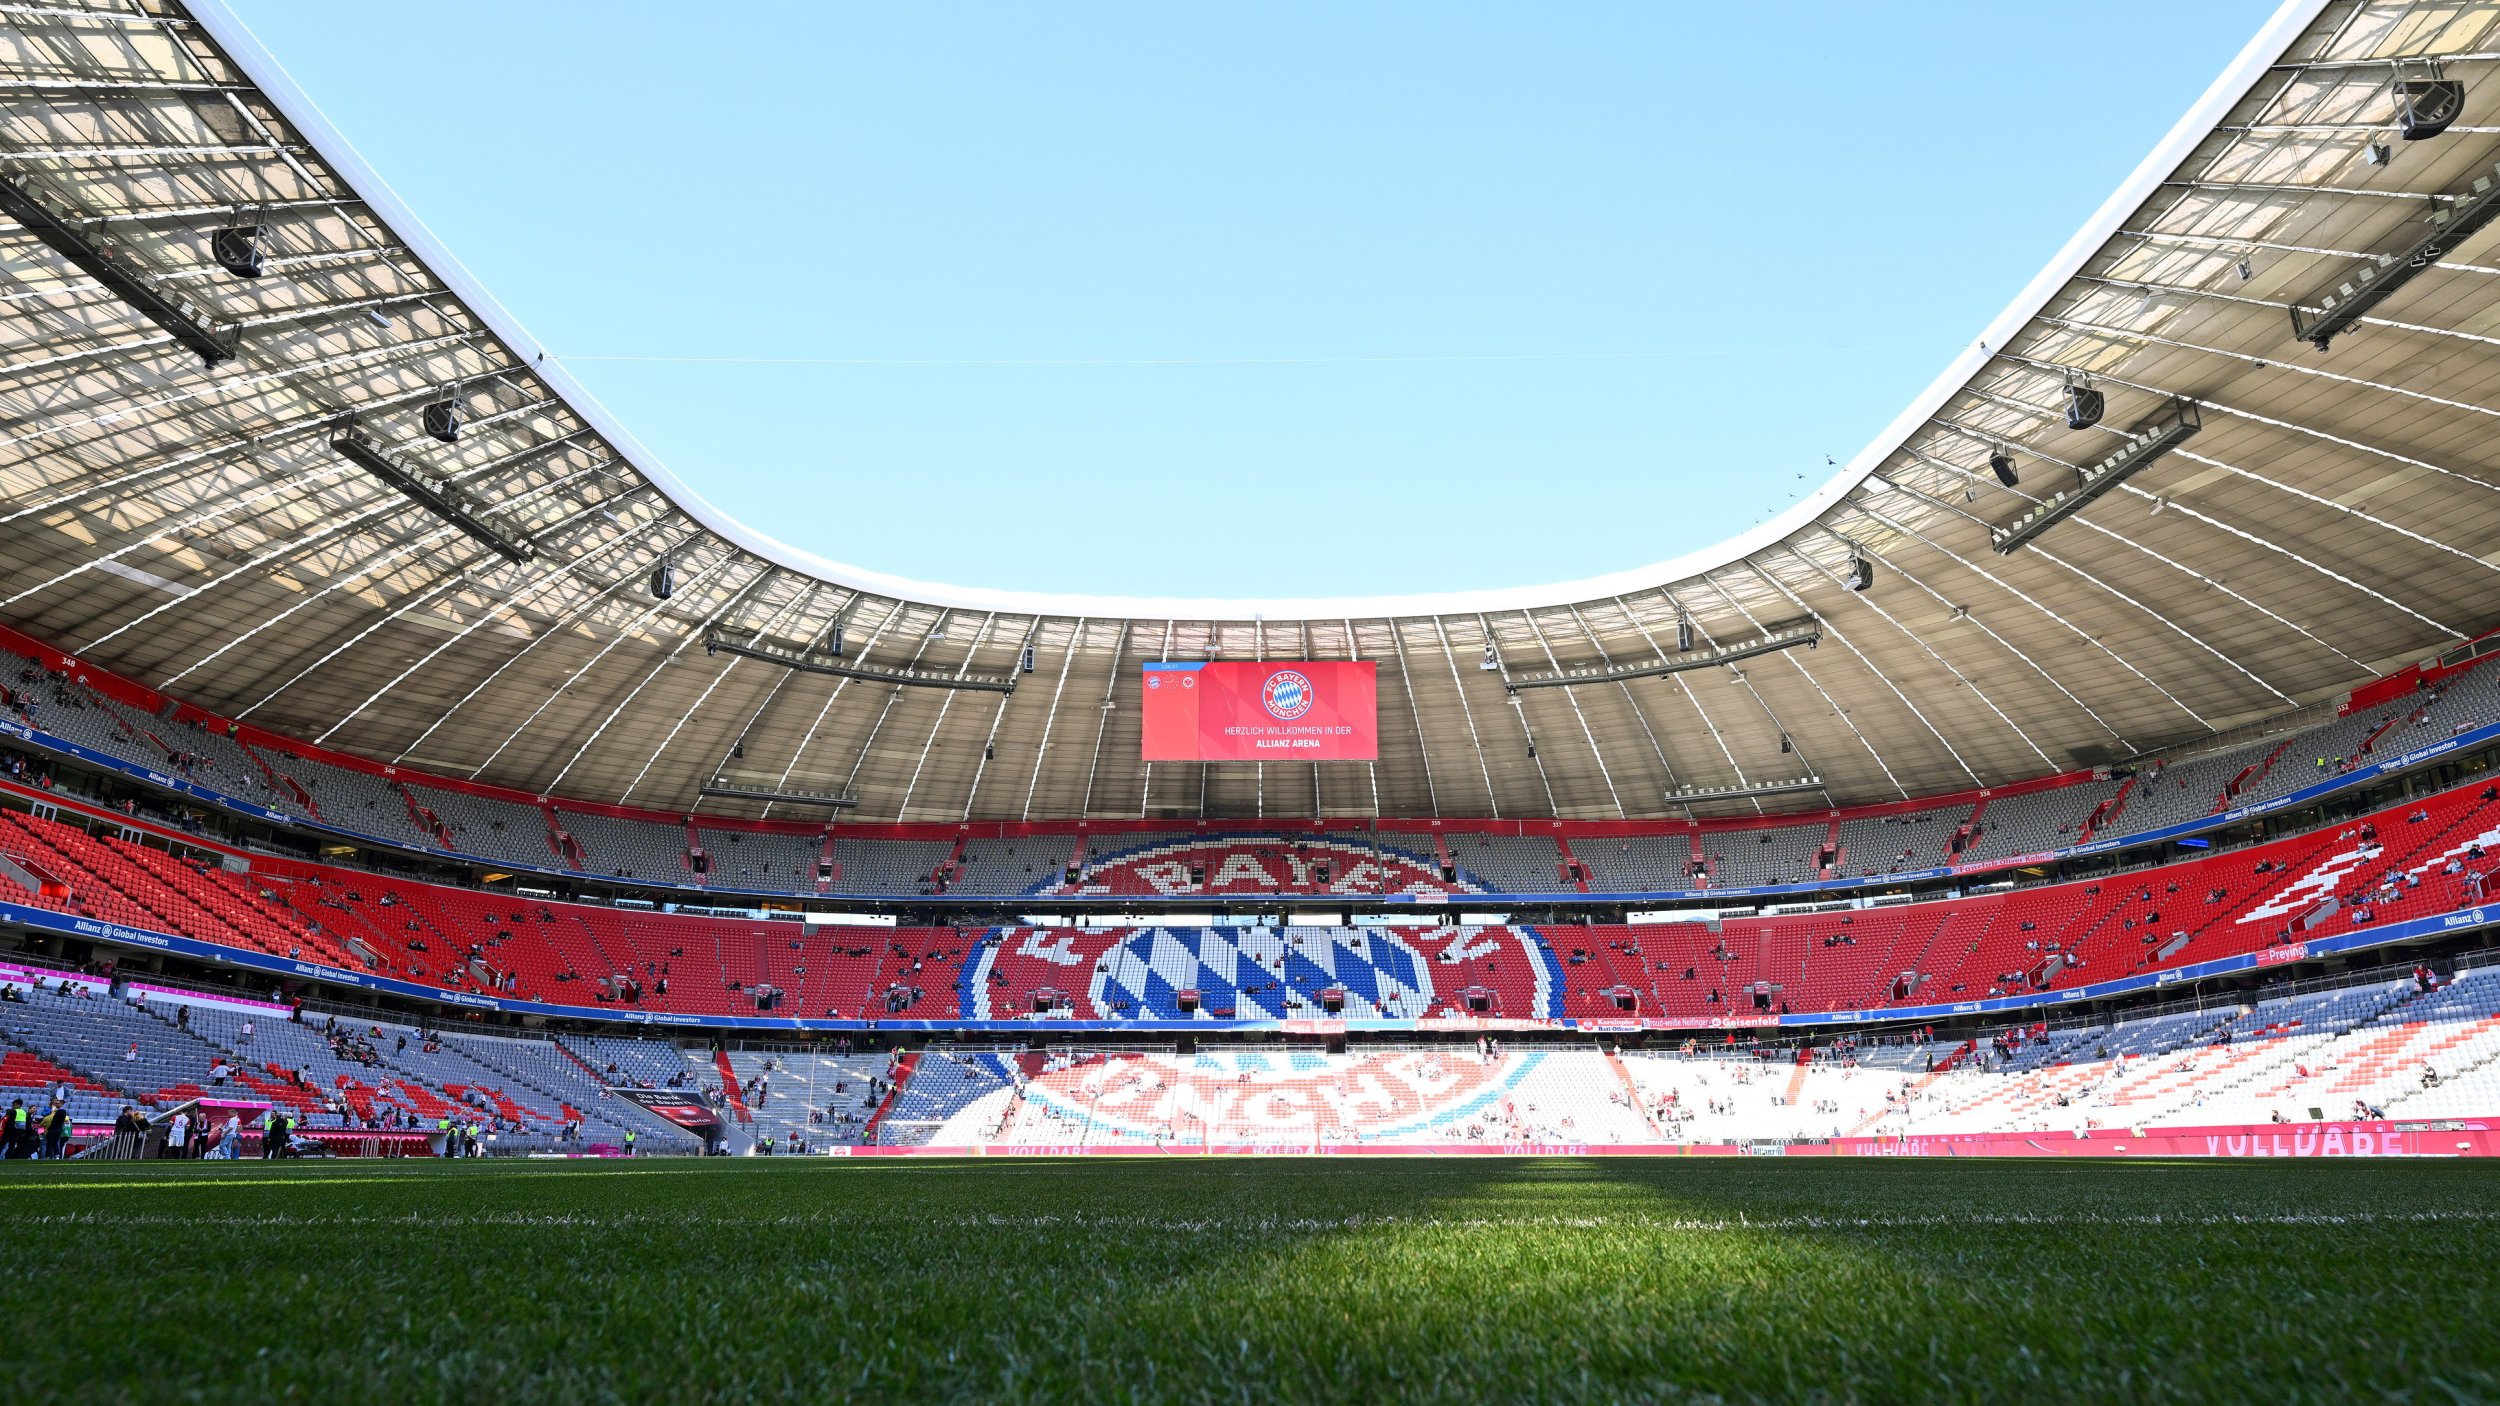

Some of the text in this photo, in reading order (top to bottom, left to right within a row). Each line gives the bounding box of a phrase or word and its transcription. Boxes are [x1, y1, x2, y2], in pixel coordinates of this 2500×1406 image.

[61, 656, 76, 668] 348
[1266, 674, 1309, 692] FC BAYERN
[1267, 700, 1309, 717] MÜNCHEN
[2337, 703, 2349, 713] 332
[1225, 726, 1351, 735] HERZLICH WILLKOMMEN IN DER
[1256, 739, 1320, 748] ALLIANZ ARENA
[2409, 749, 2429, 761] Global
[2429, 740, 2458, 754] Investors
[384, 766, 396, 775] 346
[149, 772, 167, 784] Allianz
[2225, 811, 2242, 820] Allianz
[2267, 797, 2291, 809] Investors
[265, 811, 284, 820] Allianz
[2076, 844, 2095, 853] Global
[2095, 840, 2121, 851] Investors
[1959, 852, 2046, 873] Fanclub Oliver Kahn
[1908, 871, 1933, 879] Investors
[2444, 915, 2472, 926] Allianz
[75, 920, 169, 946] Allianz Global Investors
[2268, 945, 2304, 962] Preying
[295, 963, 359, 982] Allianz Global Investors
[440, 992, 499, 1007] Allianz Global Investors
[1953, 1004, 1973, 1012] Allianz
[1314, 1020, 1345, 1033] United
[1487, 1019, 1547, 1028] OBERPFALZ
[1722, 1016, 1779, 1028] Geisenfeld
